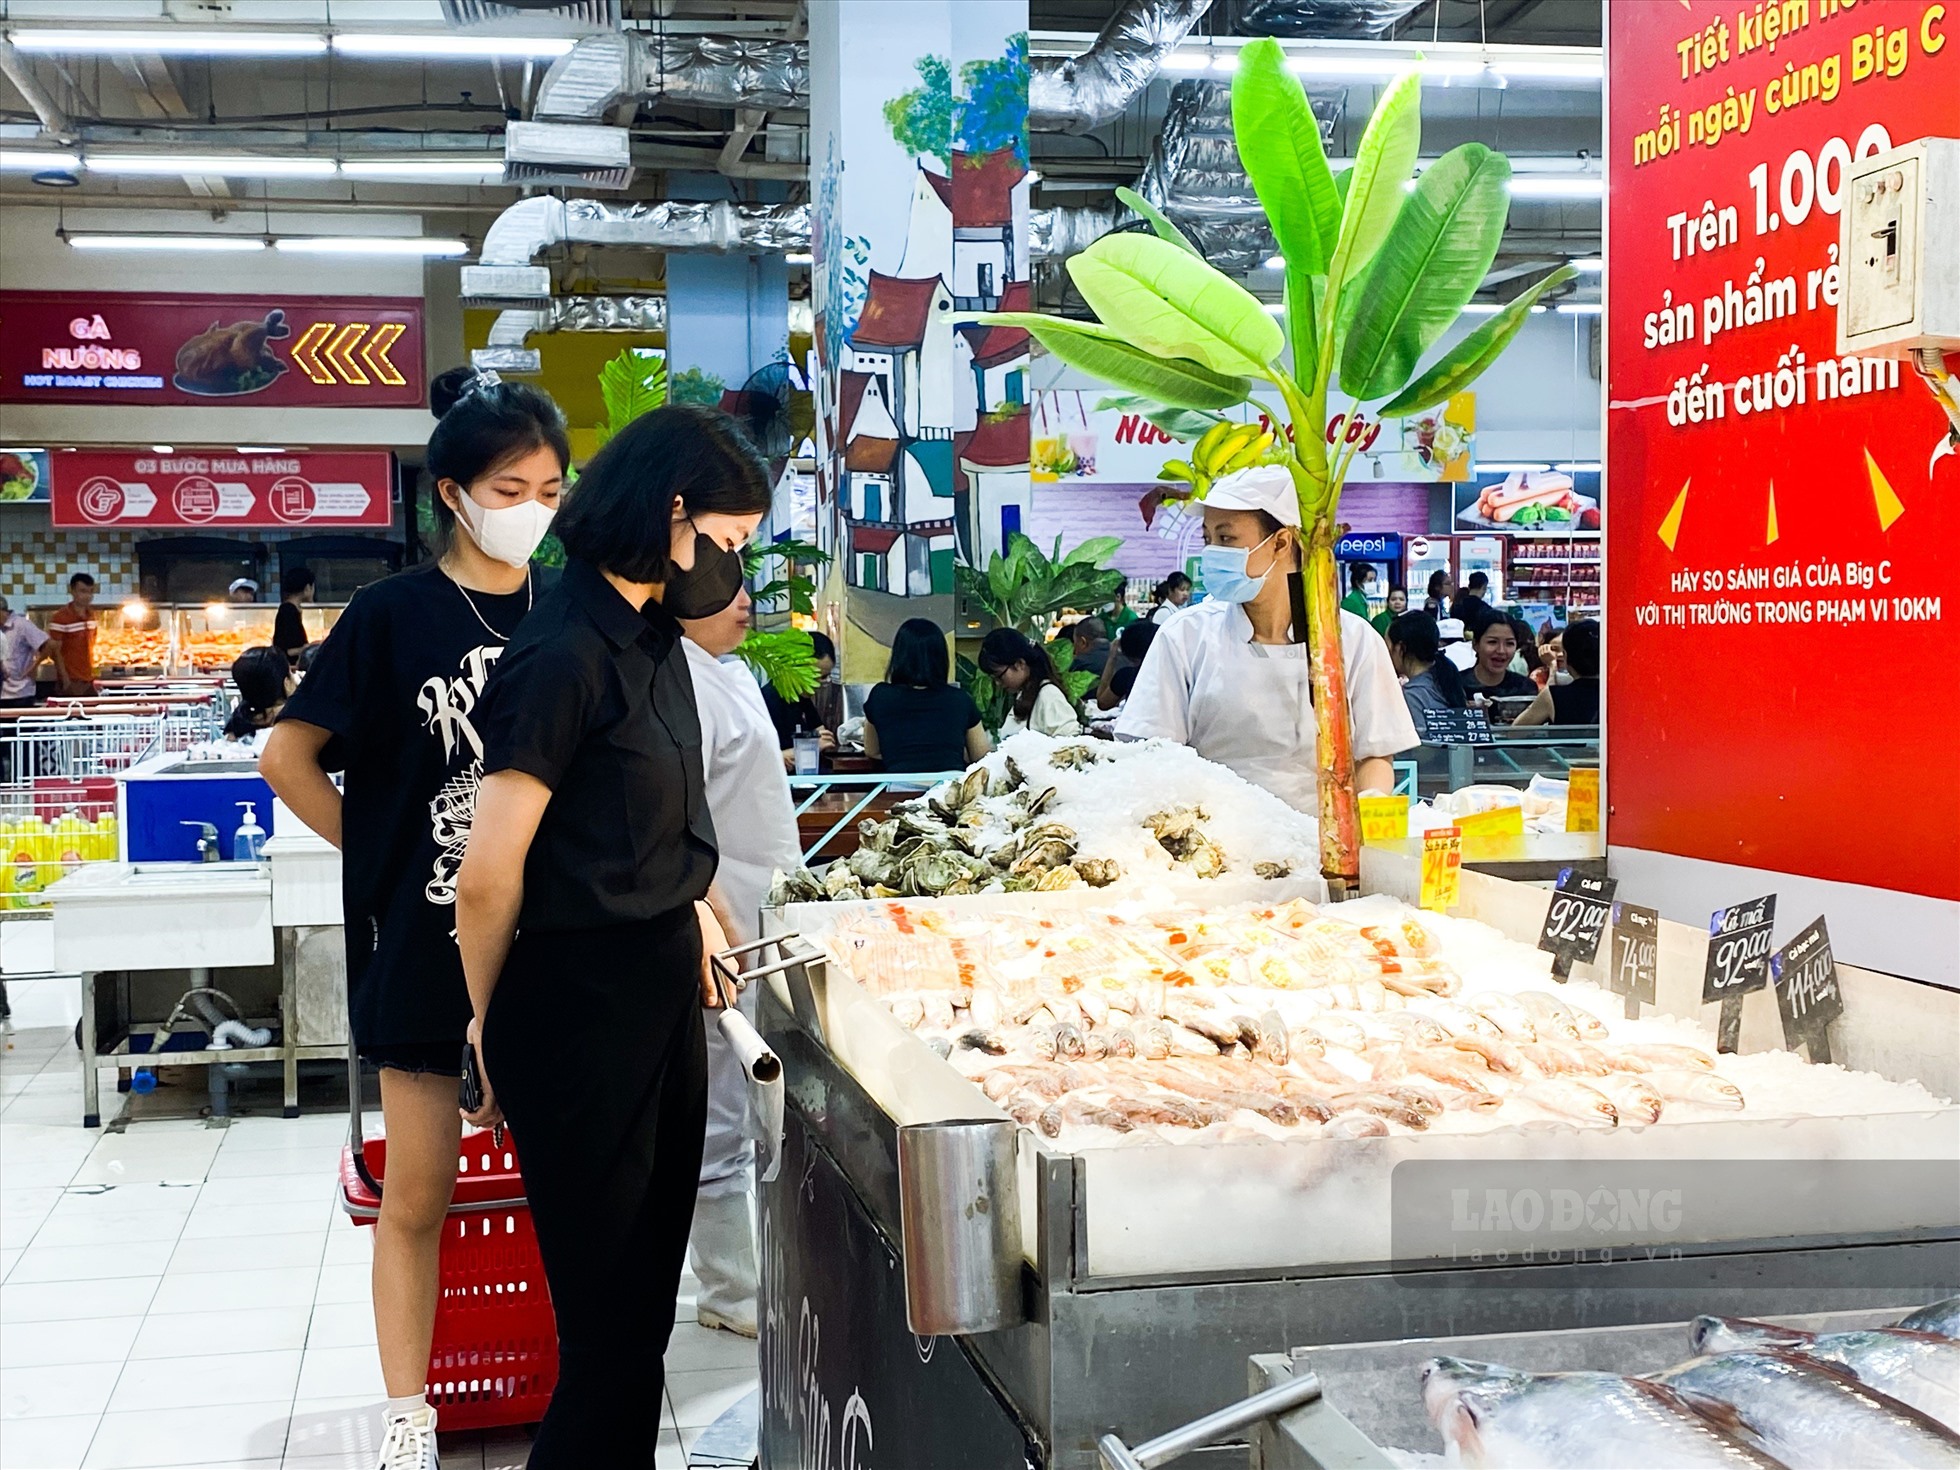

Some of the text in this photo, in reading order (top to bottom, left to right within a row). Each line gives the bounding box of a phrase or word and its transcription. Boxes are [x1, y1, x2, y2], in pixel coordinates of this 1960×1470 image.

[1677, 0, 1809, 79] Tiết kiệm
[1634, 5, 1946, 165] mỗi ngày cùng Big C
[1667, 123, 1892, 260] Trên 1.00
[1644, 290, 1694, 349] sản
[1703, 257, 1796, 345] phẩm
[69, 314, 111, 339] GÀ
[42, 344, 141, 370] NƯỚNG
[24, 375, 54, 386] HOT
[1667, 364, 1724, 427] đến
[1734, 345, 1806, 414] cuối
[135, 456, 301, 475] 03 BƯỚC MUA HÀNG
[1340, 536, 1385, 555] pepsi
[1671, 556, 1891, 592] HÃY SO SÁNH GIÁ CỦA Big C
[1635, 596, 1941, 629] VỚI THỊ TRƯỜNG TRONG PHẠM VI 10KM
